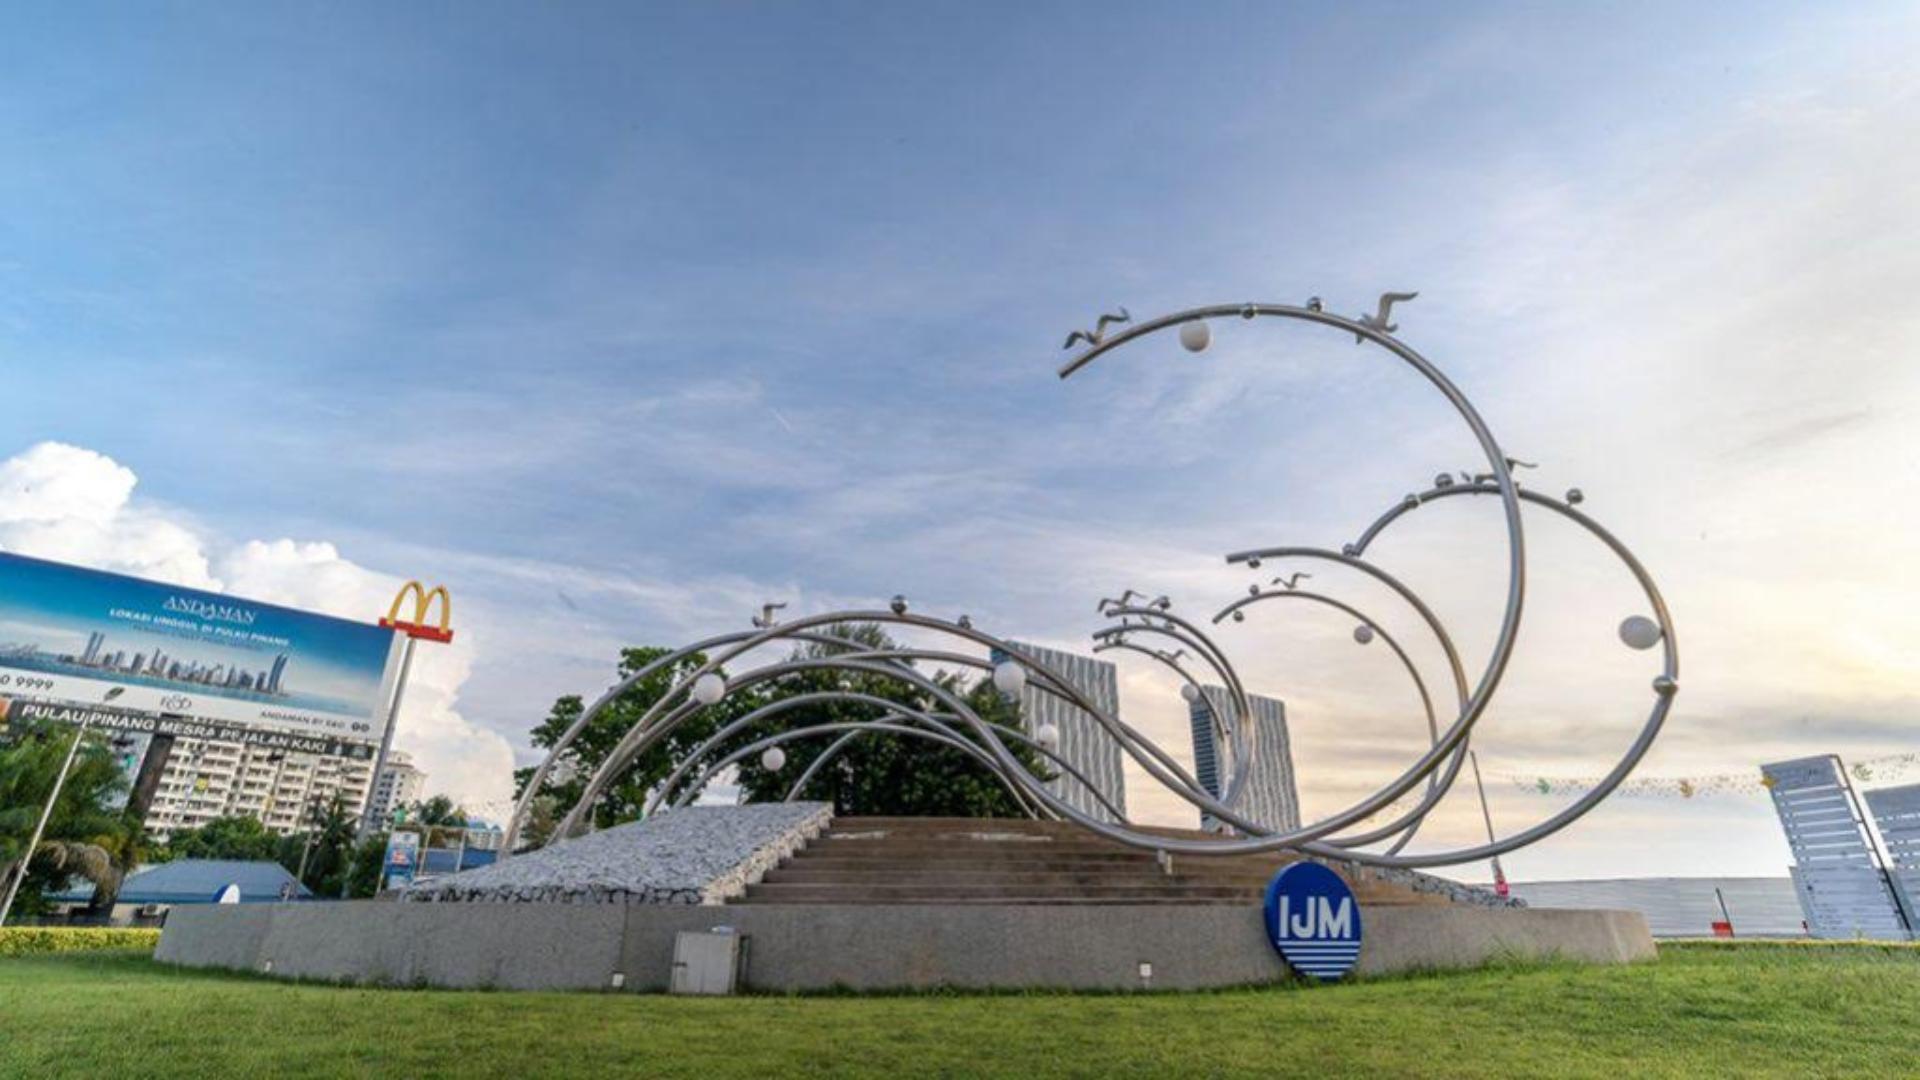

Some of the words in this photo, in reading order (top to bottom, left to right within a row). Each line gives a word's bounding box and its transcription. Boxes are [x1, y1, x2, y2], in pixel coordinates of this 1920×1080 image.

[162, 595, 256, 624] ANDAMAN
[16, 676, 54, 690] 9999
[22, 704, 86, 723] PULAU
[89, 711, 156, 730] PINANG
[159, 721, 216, 736] MESRA
[219, 729, 288, 747] PEJALAN
[290, 737, 327, 753] KAKI
[1279, 895, 1351, 938] IJM
